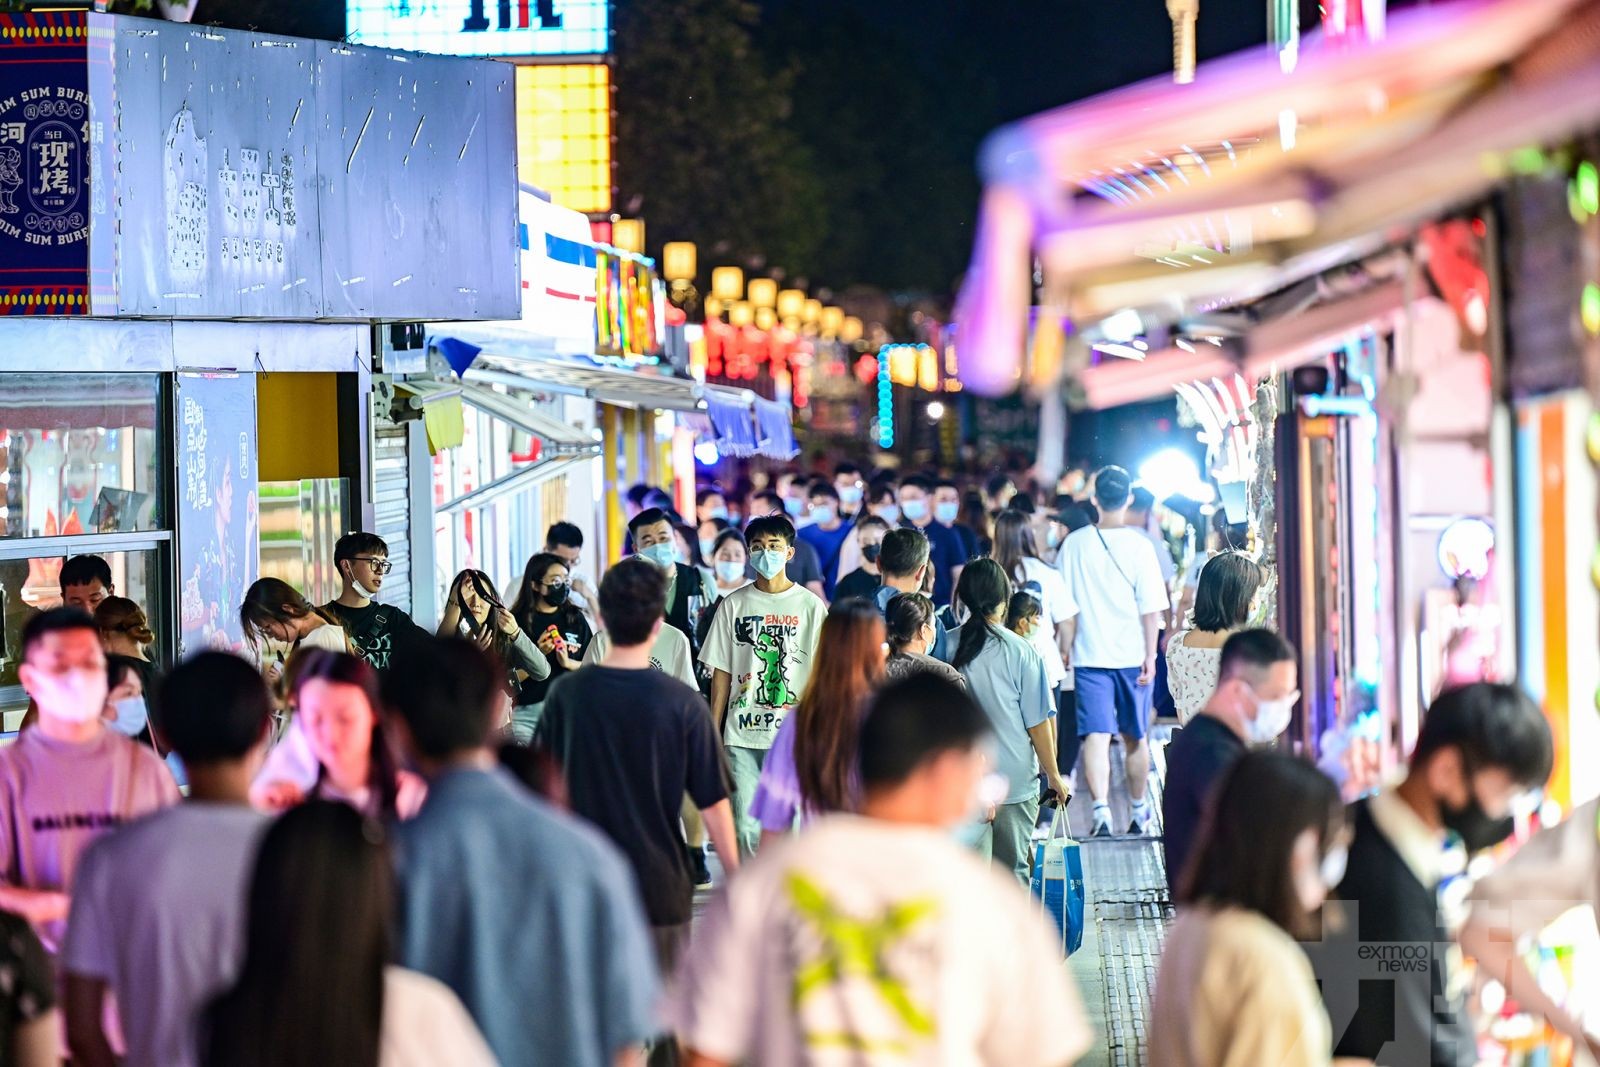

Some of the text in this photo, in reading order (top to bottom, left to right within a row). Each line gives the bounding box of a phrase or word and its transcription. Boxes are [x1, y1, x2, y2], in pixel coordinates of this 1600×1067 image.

[0, 97, 17, 115] IM
[21, 86, 50, 102] SUM
[0, 122, 26, 144] 河
[44, 130, 62, 139] 当日
[39, 141, 69, 195] 现烤
[24, 232, 52, 246] SUM
